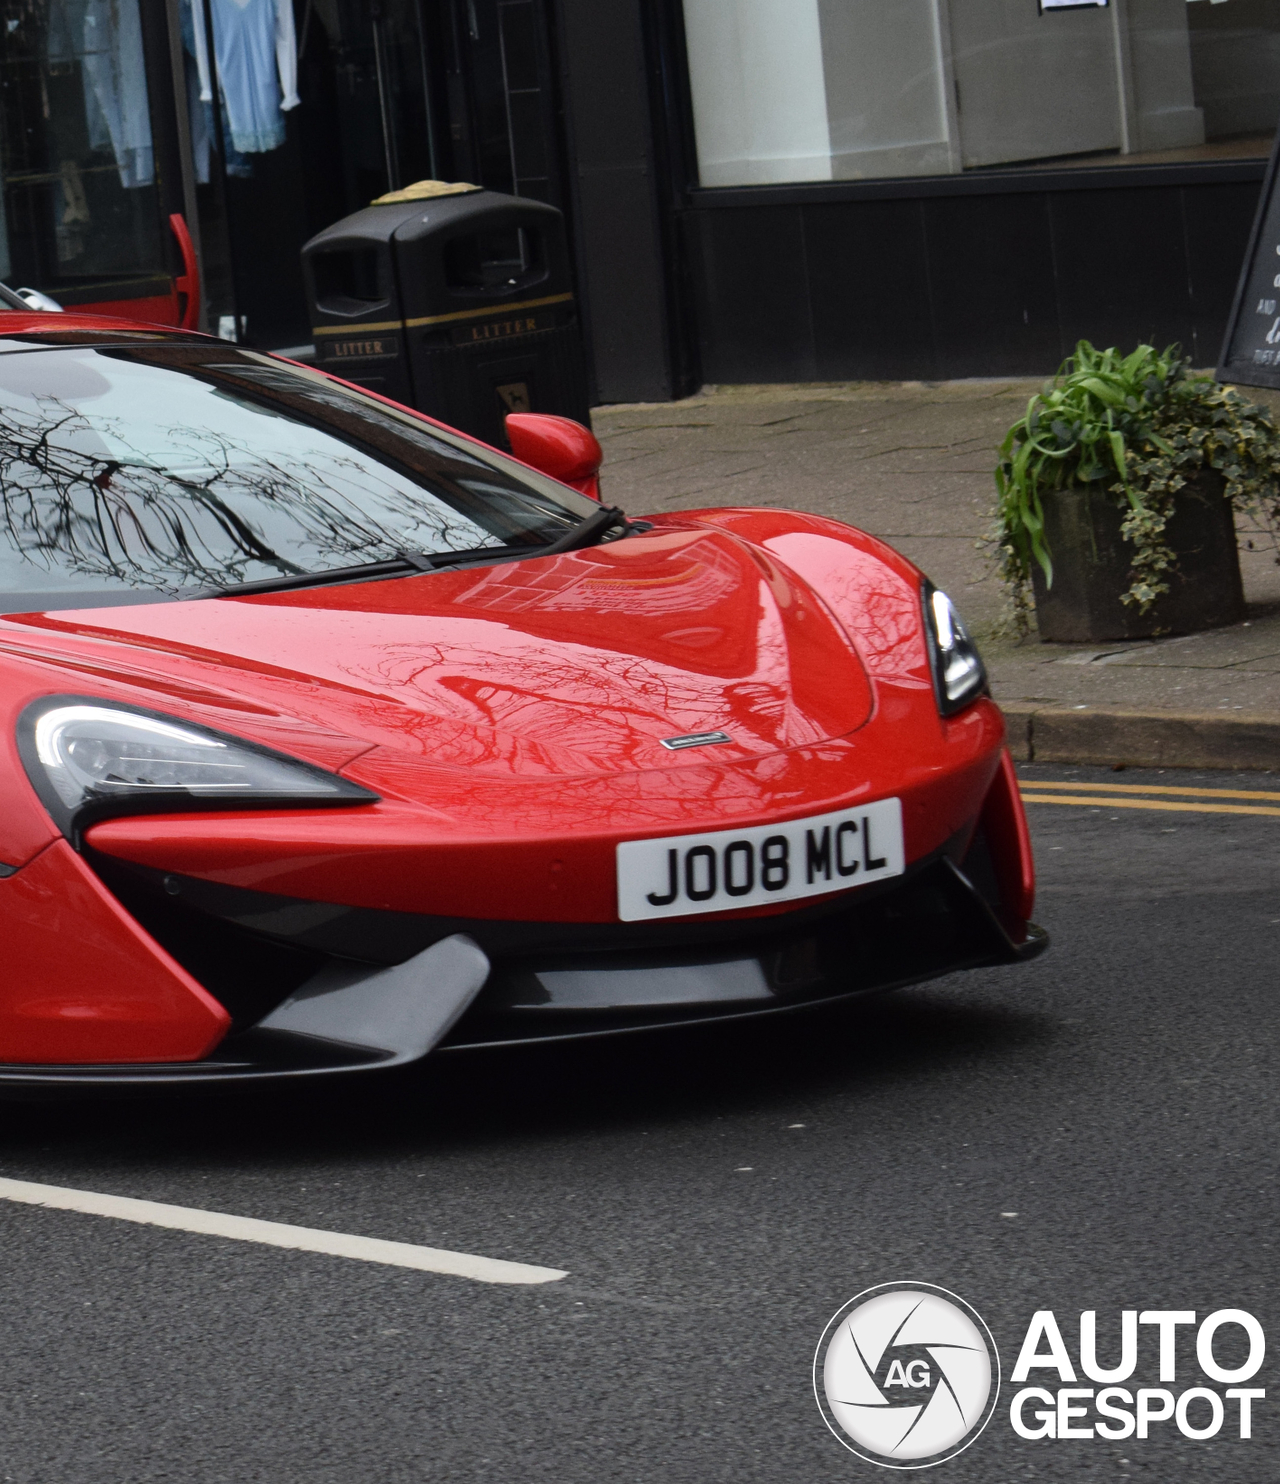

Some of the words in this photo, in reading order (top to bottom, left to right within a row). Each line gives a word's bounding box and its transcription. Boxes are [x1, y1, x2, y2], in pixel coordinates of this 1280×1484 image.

[472, 318, 536, 340] LITTER
[334, 341, 383, 356] LITTER
[806, 817, 887, 885] MCL
